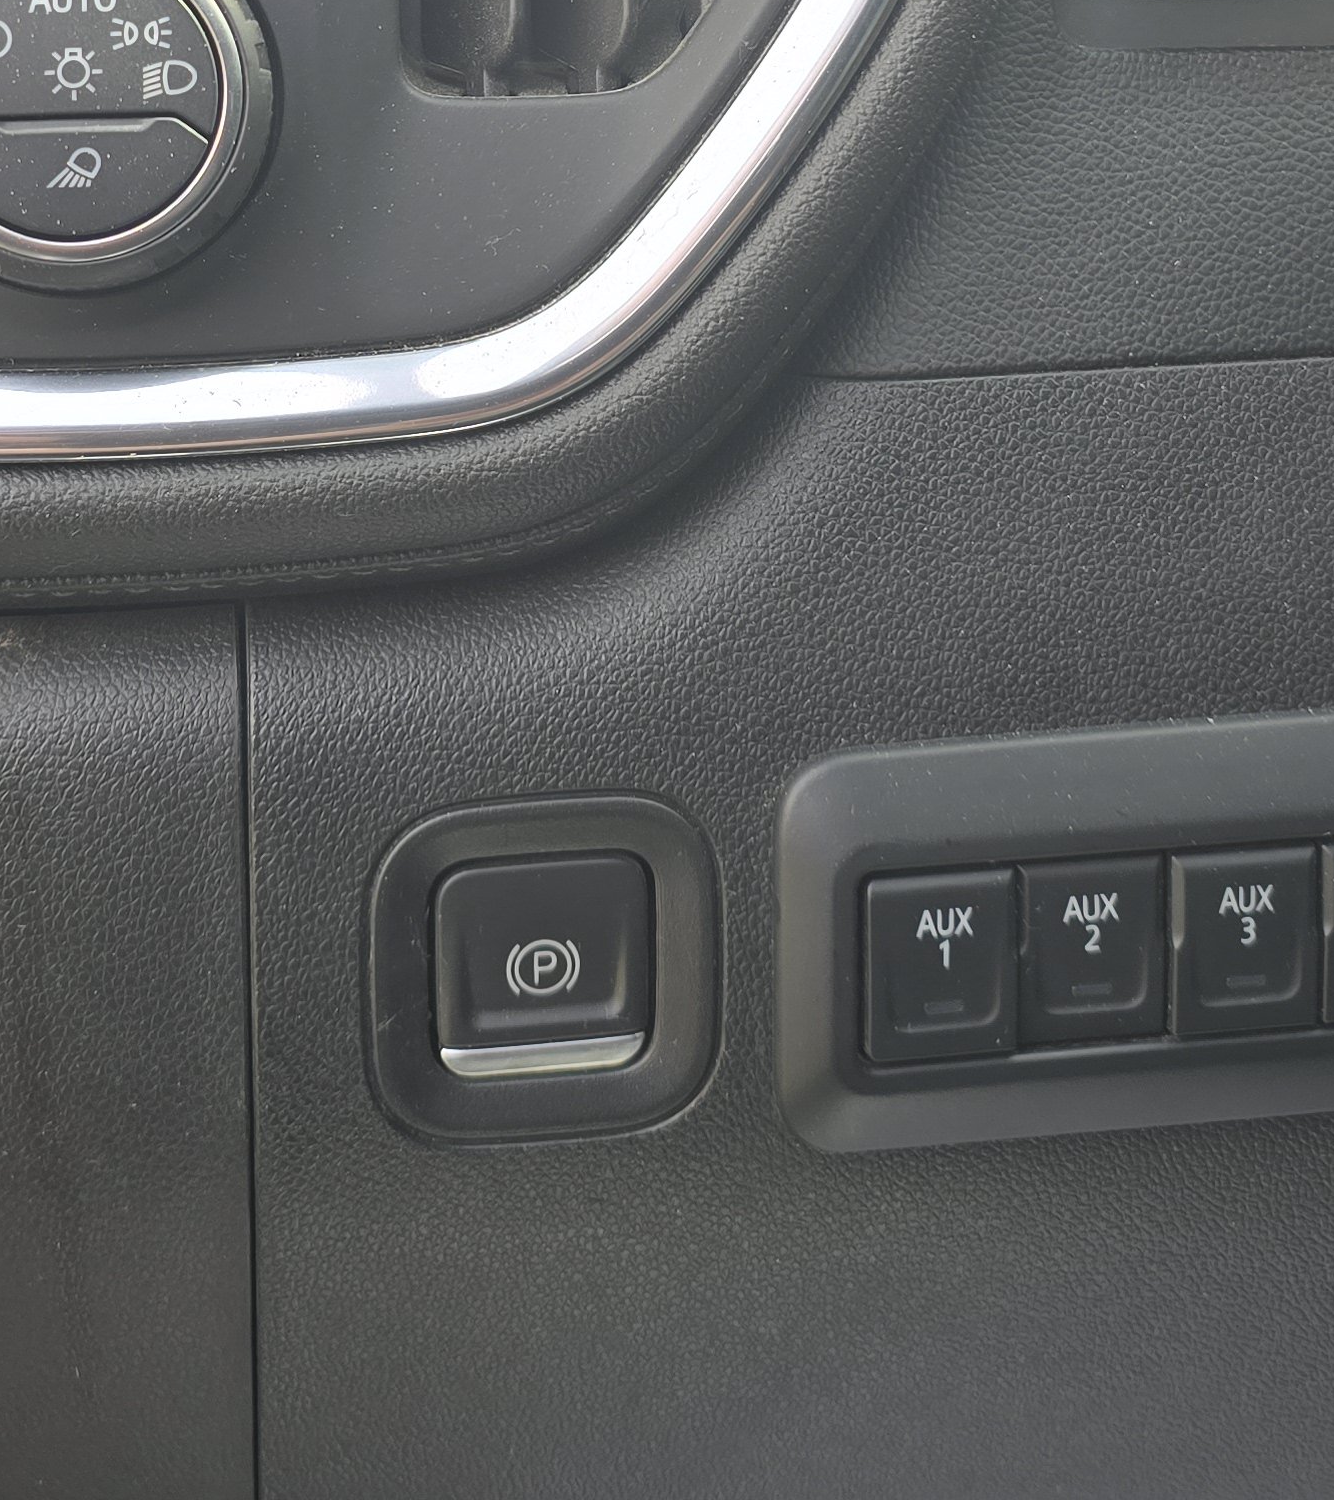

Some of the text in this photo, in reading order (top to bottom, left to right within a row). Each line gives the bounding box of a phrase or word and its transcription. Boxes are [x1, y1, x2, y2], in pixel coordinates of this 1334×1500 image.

[1062, 892, 1120, 925] AUX
[1218, 883, 1276, 915] AUX
[916, 906, 974, 939] AUX
[1240, 916, 1258, 946] 3
[1083, 924, 1102, 953] 2
[938, 939, 950, 970] 1
